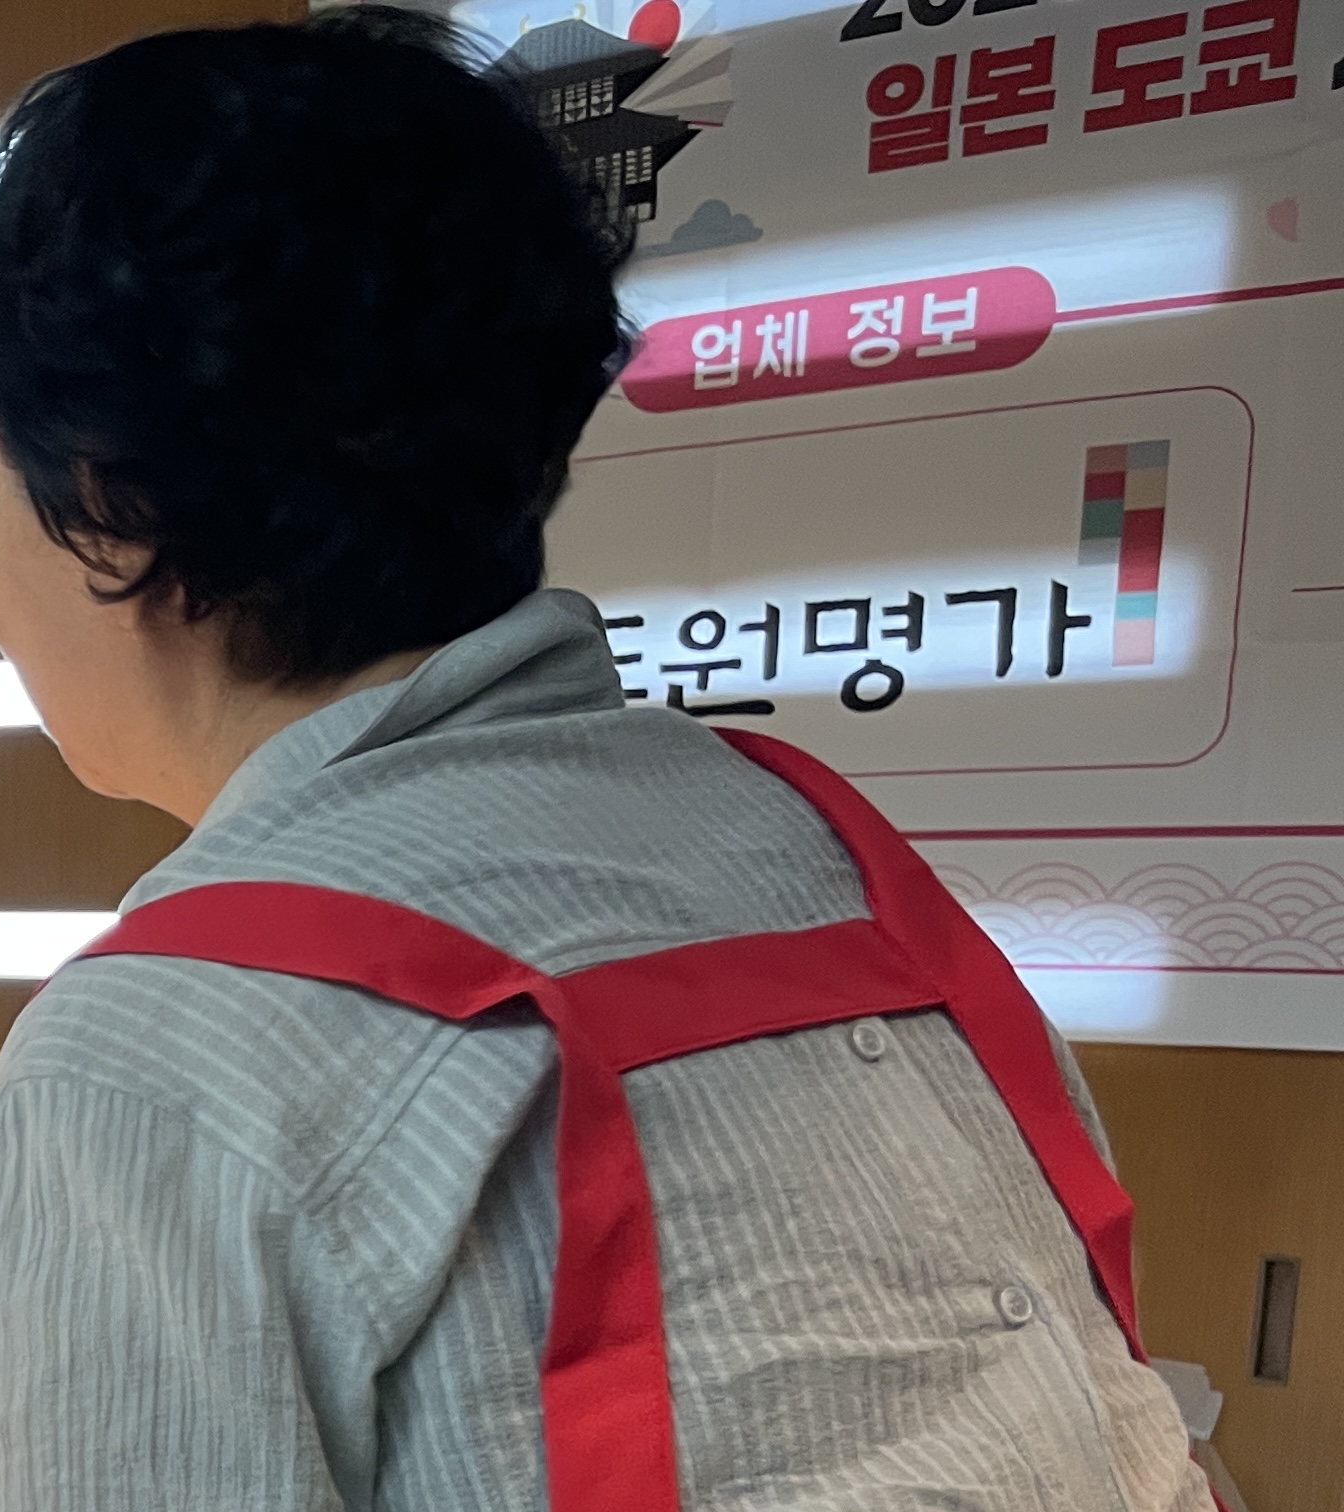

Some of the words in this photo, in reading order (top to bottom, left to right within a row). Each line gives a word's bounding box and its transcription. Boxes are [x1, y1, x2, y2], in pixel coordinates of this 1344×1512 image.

[866, 35, 1056, 174] 일본
[1083, 0, 1301, 133] 도쿄
[691, 309, 807, 390] 업체
[848, 287, 980, 366] 정보
